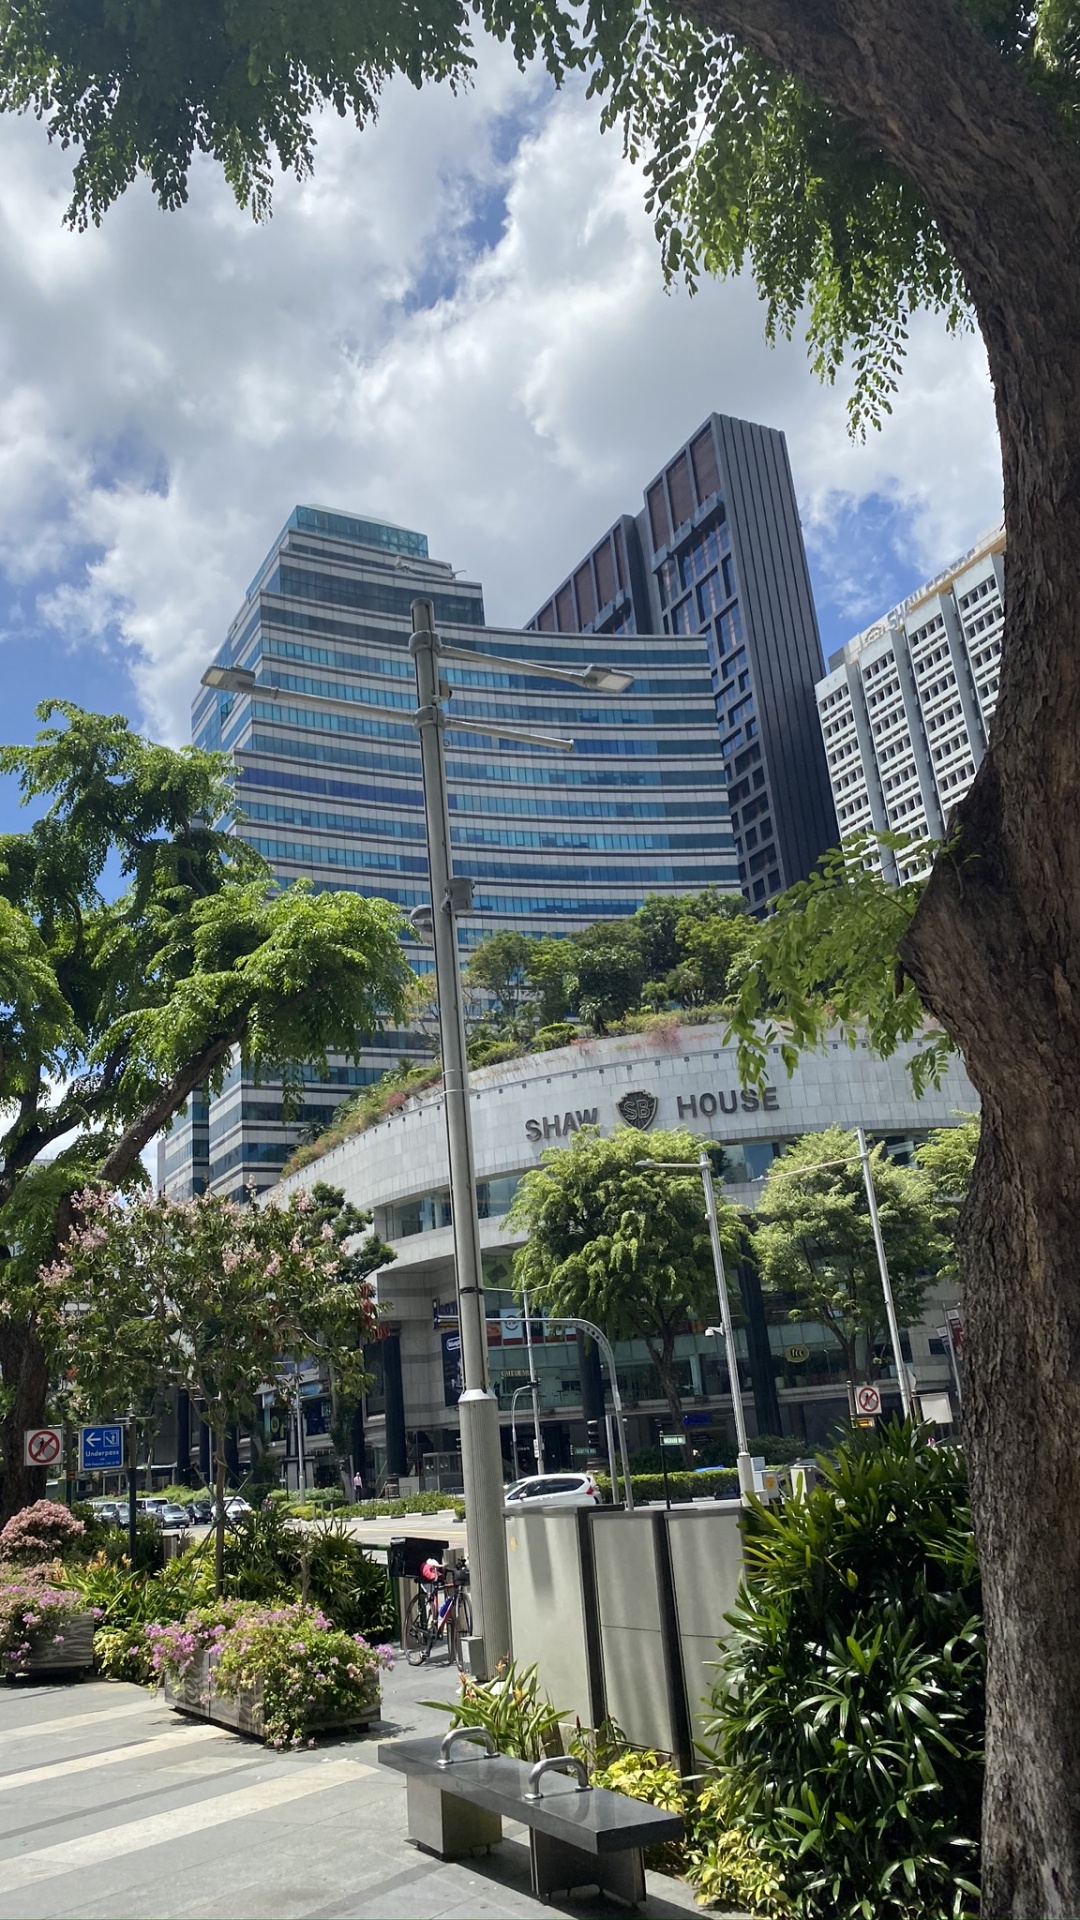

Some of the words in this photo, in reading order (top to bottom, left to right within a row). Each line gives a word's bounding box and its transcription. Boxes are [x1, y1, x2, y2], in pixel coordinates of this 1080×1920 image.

[525, 1108, 598, 1142] SHAW
[677, 1087, 780, 1119] HOUSE
[623, 1100, 651, 1120] SB
